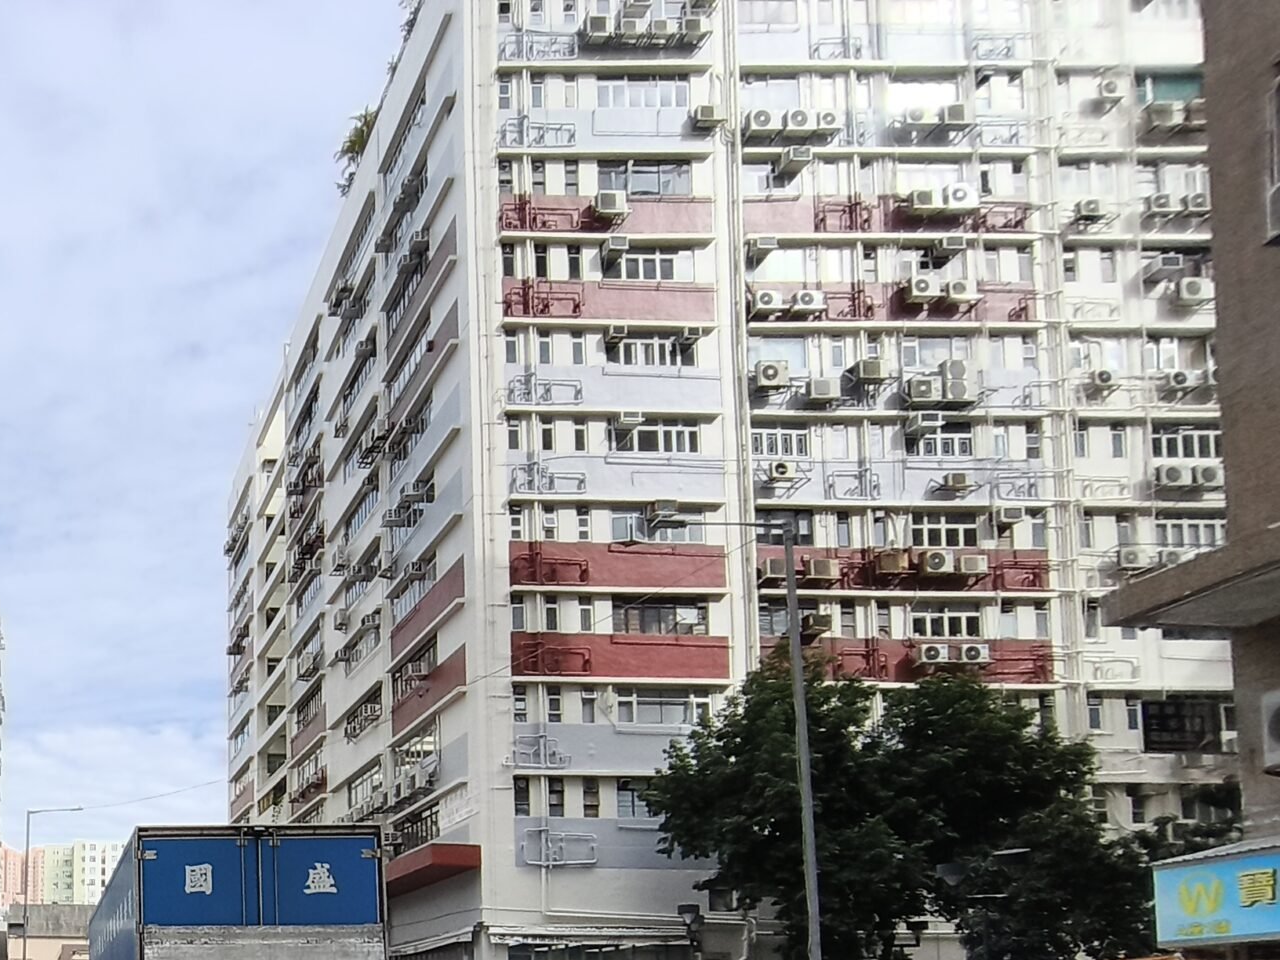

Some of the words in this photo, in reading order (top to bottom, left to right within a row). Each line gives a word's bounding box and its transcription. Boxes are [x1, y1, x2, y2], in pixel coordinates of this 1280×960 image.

[184, 863, 213, 895] 國
[303, 862, 338, 894] 盛
[1237, 868, 1277, 908] 寶
